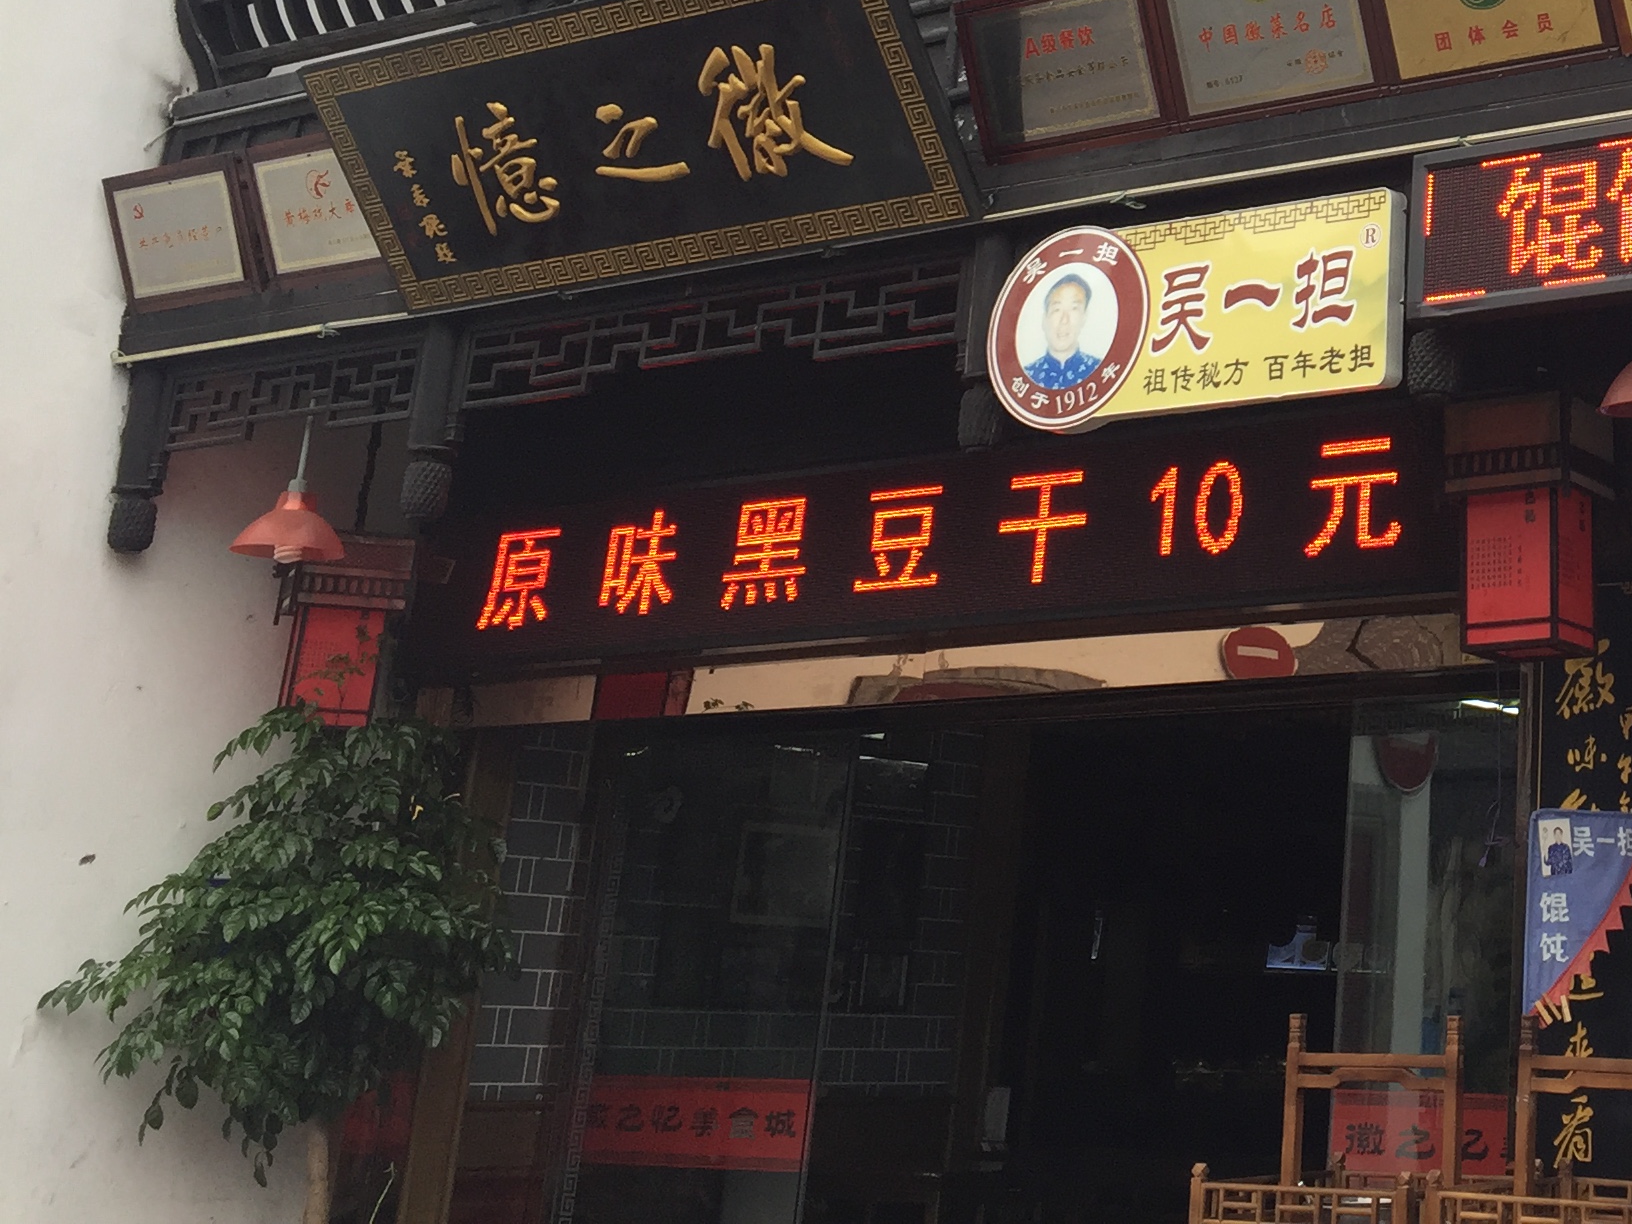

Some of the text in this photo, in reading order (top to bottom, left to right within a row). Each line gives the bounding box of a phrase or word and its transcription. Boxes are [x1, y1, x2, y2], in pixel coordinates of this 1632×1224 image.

[1024, 25, 1096, 61] A级餐饮
[1198, 3, 1337, 53] 中国徽菜名店
[1434, 12, 1553, 52] 团体会员
[1023, 242, 1120, 284] 吴一担
[1151, 249, 1354, 353] 吴一担
[1011, 362, 1121, 414] 创于1912年
[1143, 343, 1375, 395] 祖传秘方 百年老担
[1540, 892, 1569, 962] 馄饨
